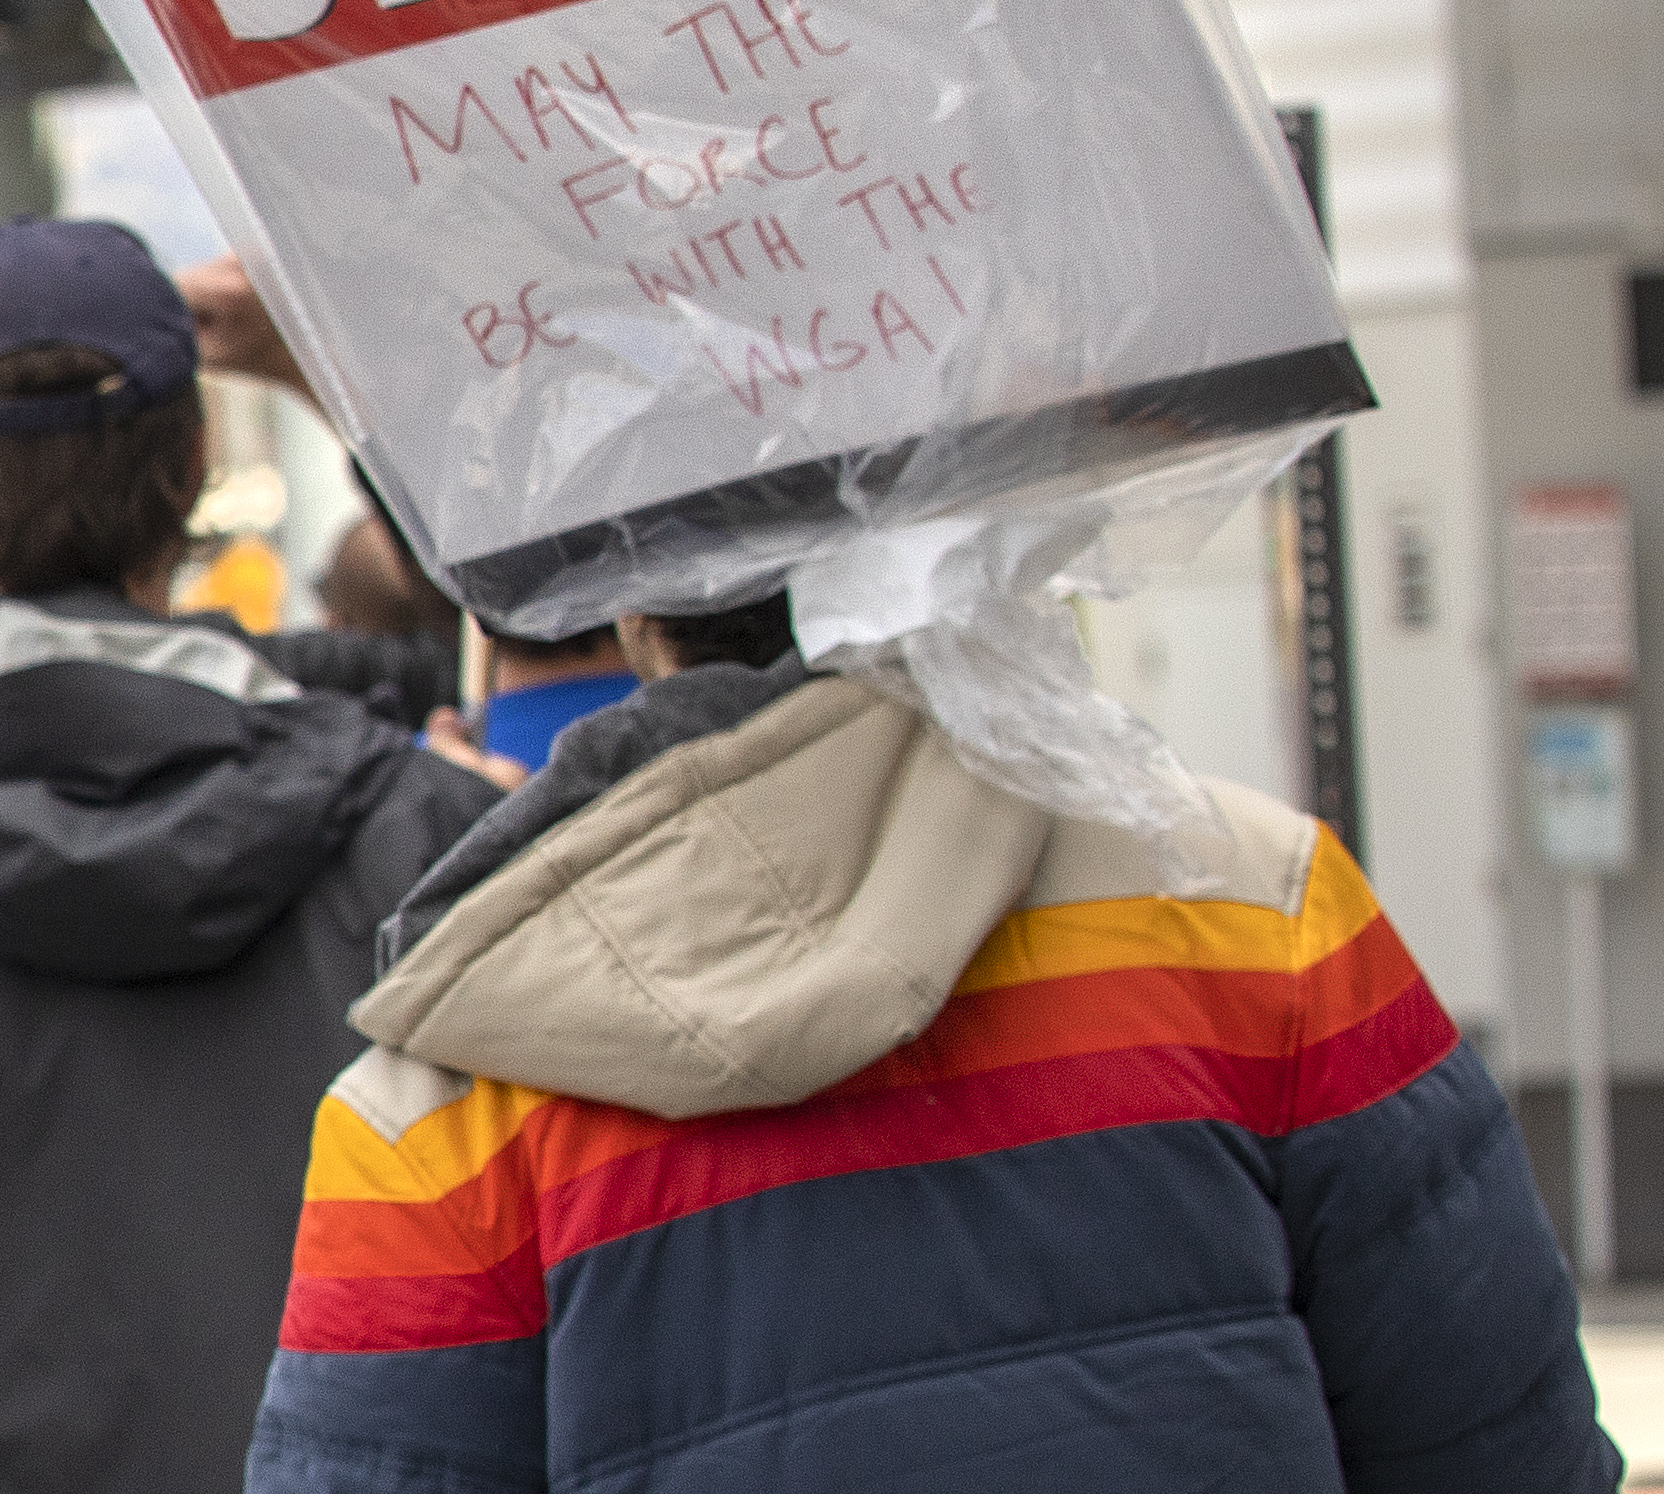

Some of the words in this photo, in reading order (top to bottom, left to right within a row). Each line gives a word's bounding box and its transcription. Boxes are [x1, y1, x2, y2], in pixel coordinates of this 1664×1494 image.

[388, 52, 638, 186] MAY
[559, 97, 868, 240] FORCE
[462, 280, 580, 370] BE
[626, 213, 806, 307] WITH
[837, 162, 992, 251] THE
